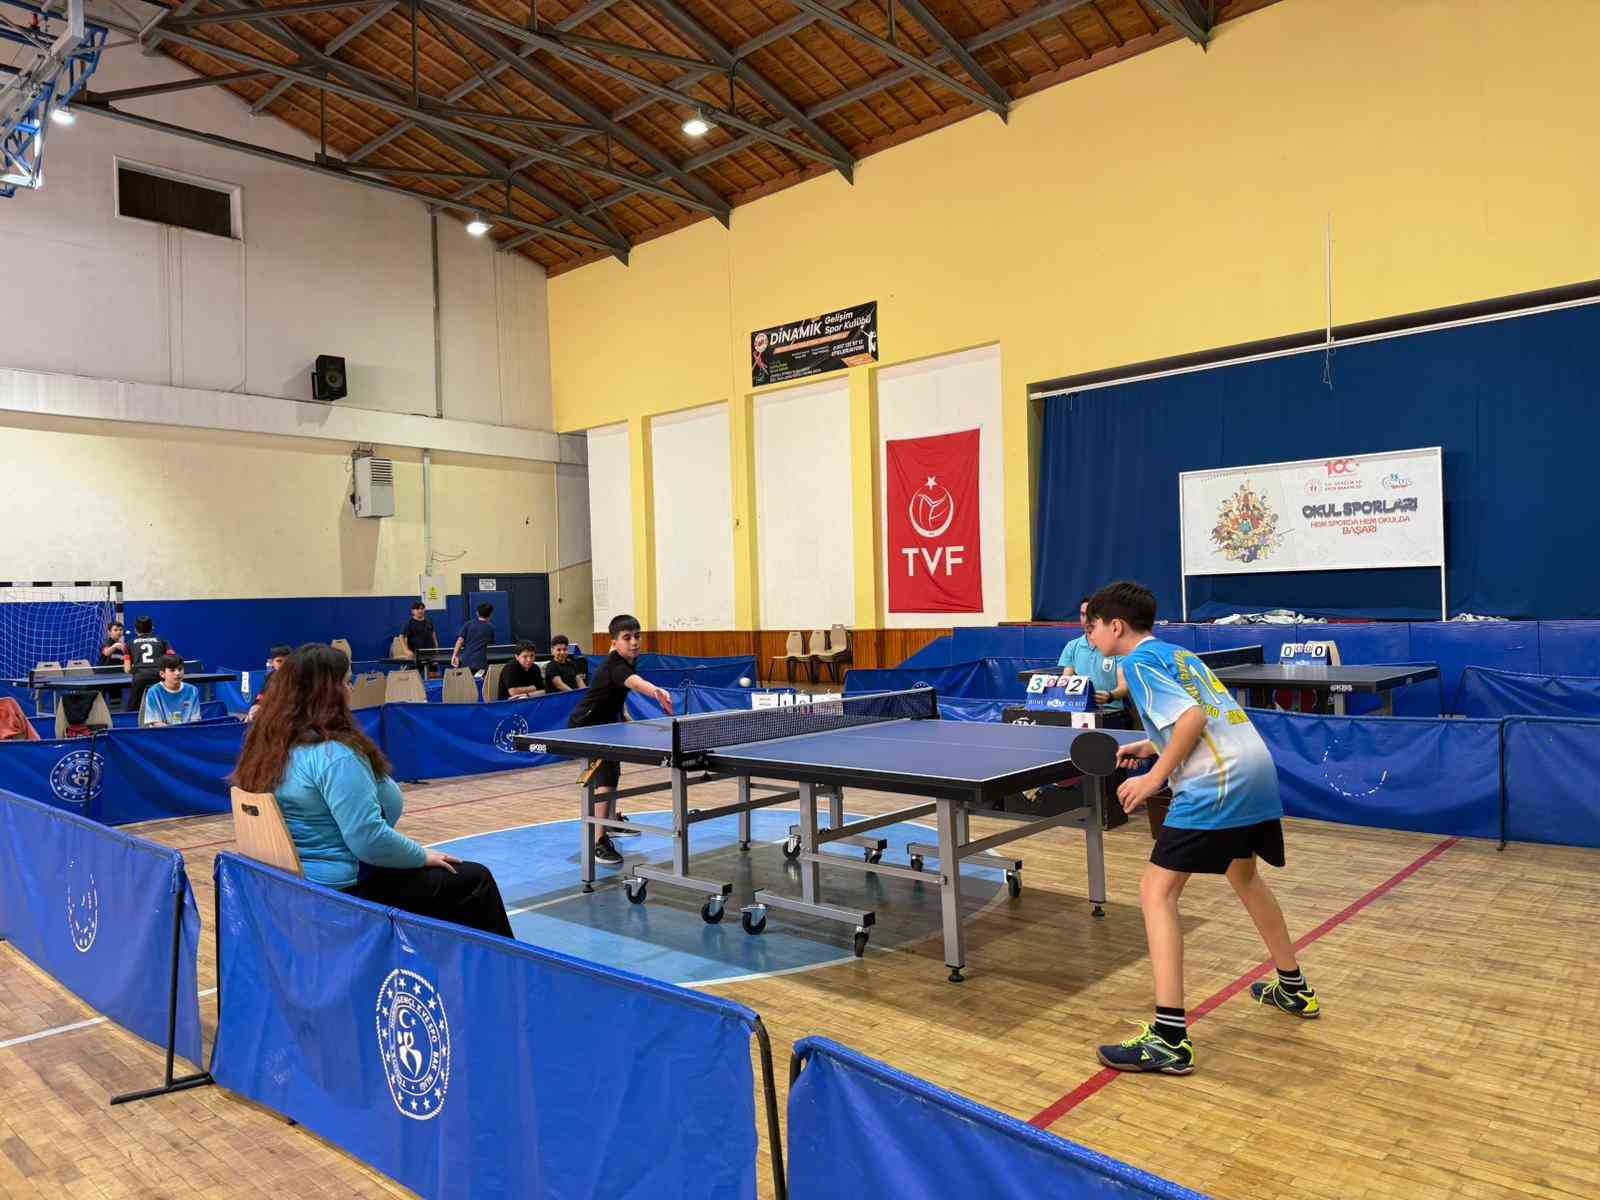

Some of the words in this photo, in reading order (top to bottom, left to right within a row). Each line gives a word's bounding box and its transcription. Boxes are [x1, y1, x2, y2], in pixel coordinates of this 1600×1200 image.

[824, 311, 854, 325] Gelişim
[770, 320, 823, 346] DİNAMİK
[1302, 503, 1342, 519] OKUL
[1343, 496, 1418, 516] SPORLARI
[1328, 518, 1359, 528] SPORDA
[1360, 517, 1376, 526] HEM
[1378, 515, 1410, 524] OKULDA
[1343, 525, 1377, 536] BAŞARI
[901, 546, 965, 577] TVF
[140, 643, 154, 663] 2
[1284, 646, 1292, 657] 0
[1315, 645, 1323, 656] 0
[1031, 677, 1043, 691] 3
[1069, 678, 1083, 692] 2
